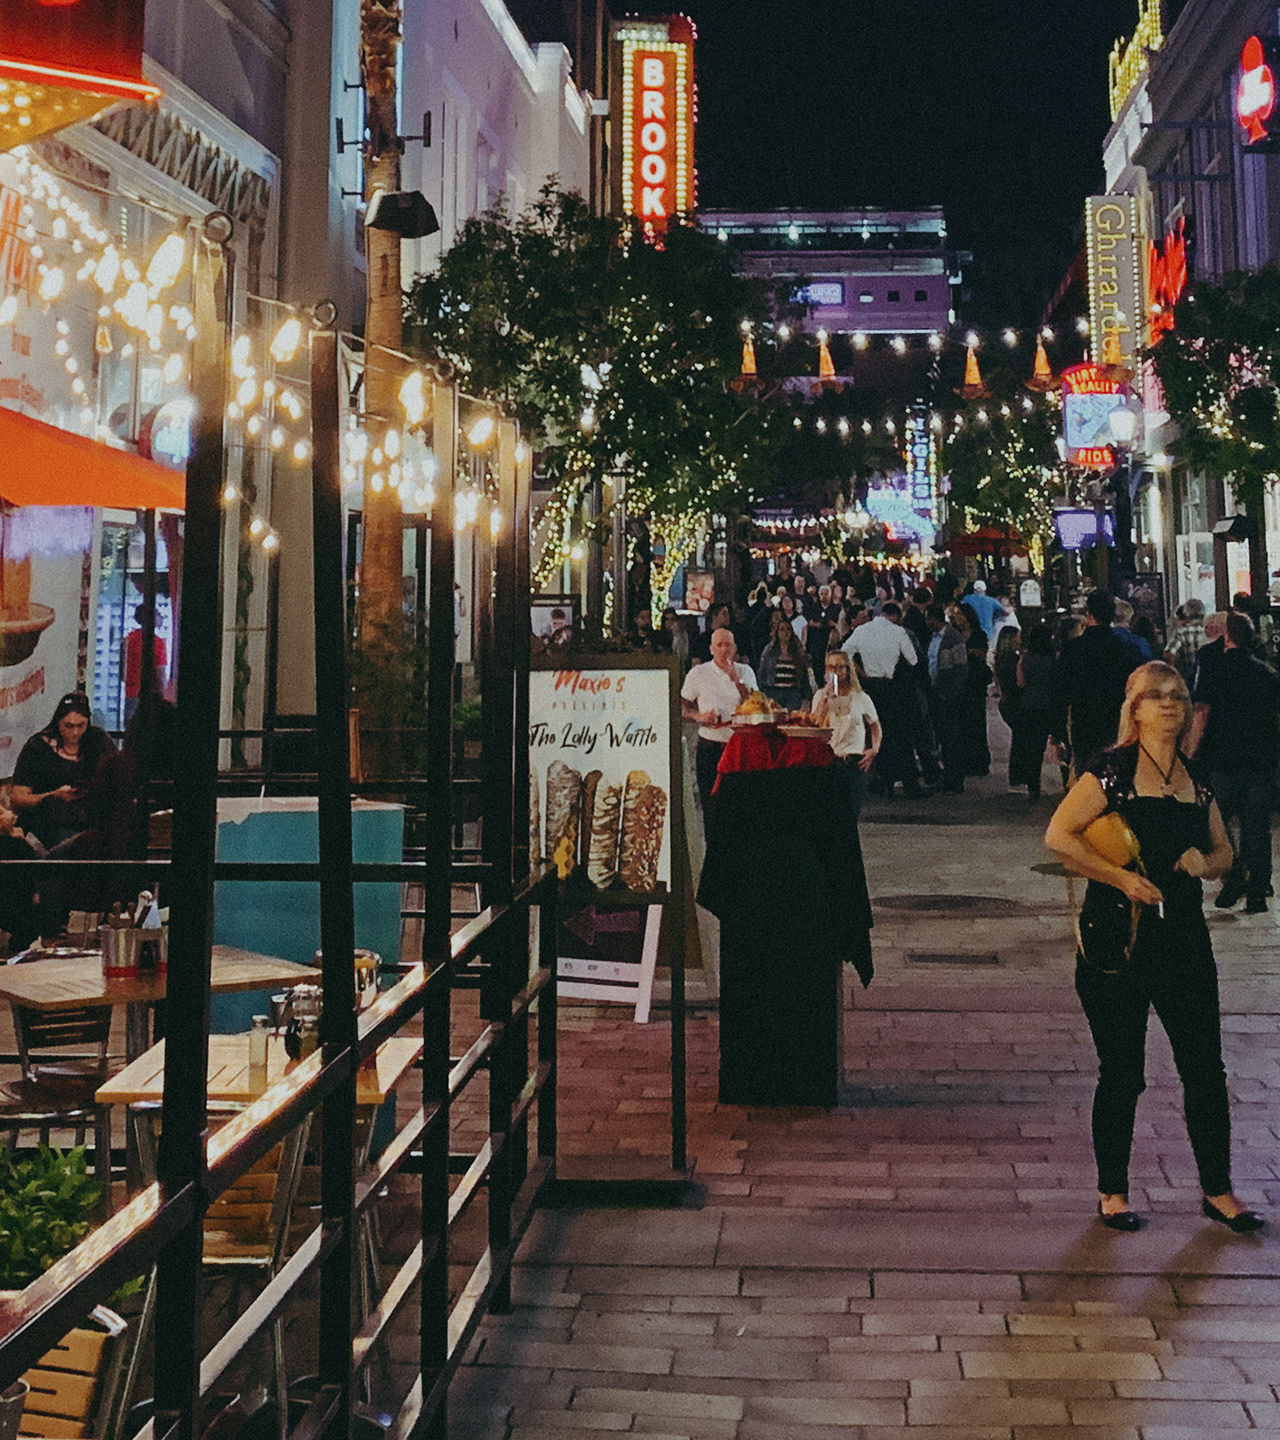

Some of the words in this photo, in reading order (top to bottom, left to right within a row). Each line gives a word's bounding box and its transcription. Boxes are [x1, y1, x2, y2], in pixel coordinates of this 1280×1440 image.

[1095, 203, 1133, 366] Ghirardl
[1065, 367, 1098, 385] VIRT
[552, 669, 626, 695] Maxies
[529, 722, 557, 748] The
